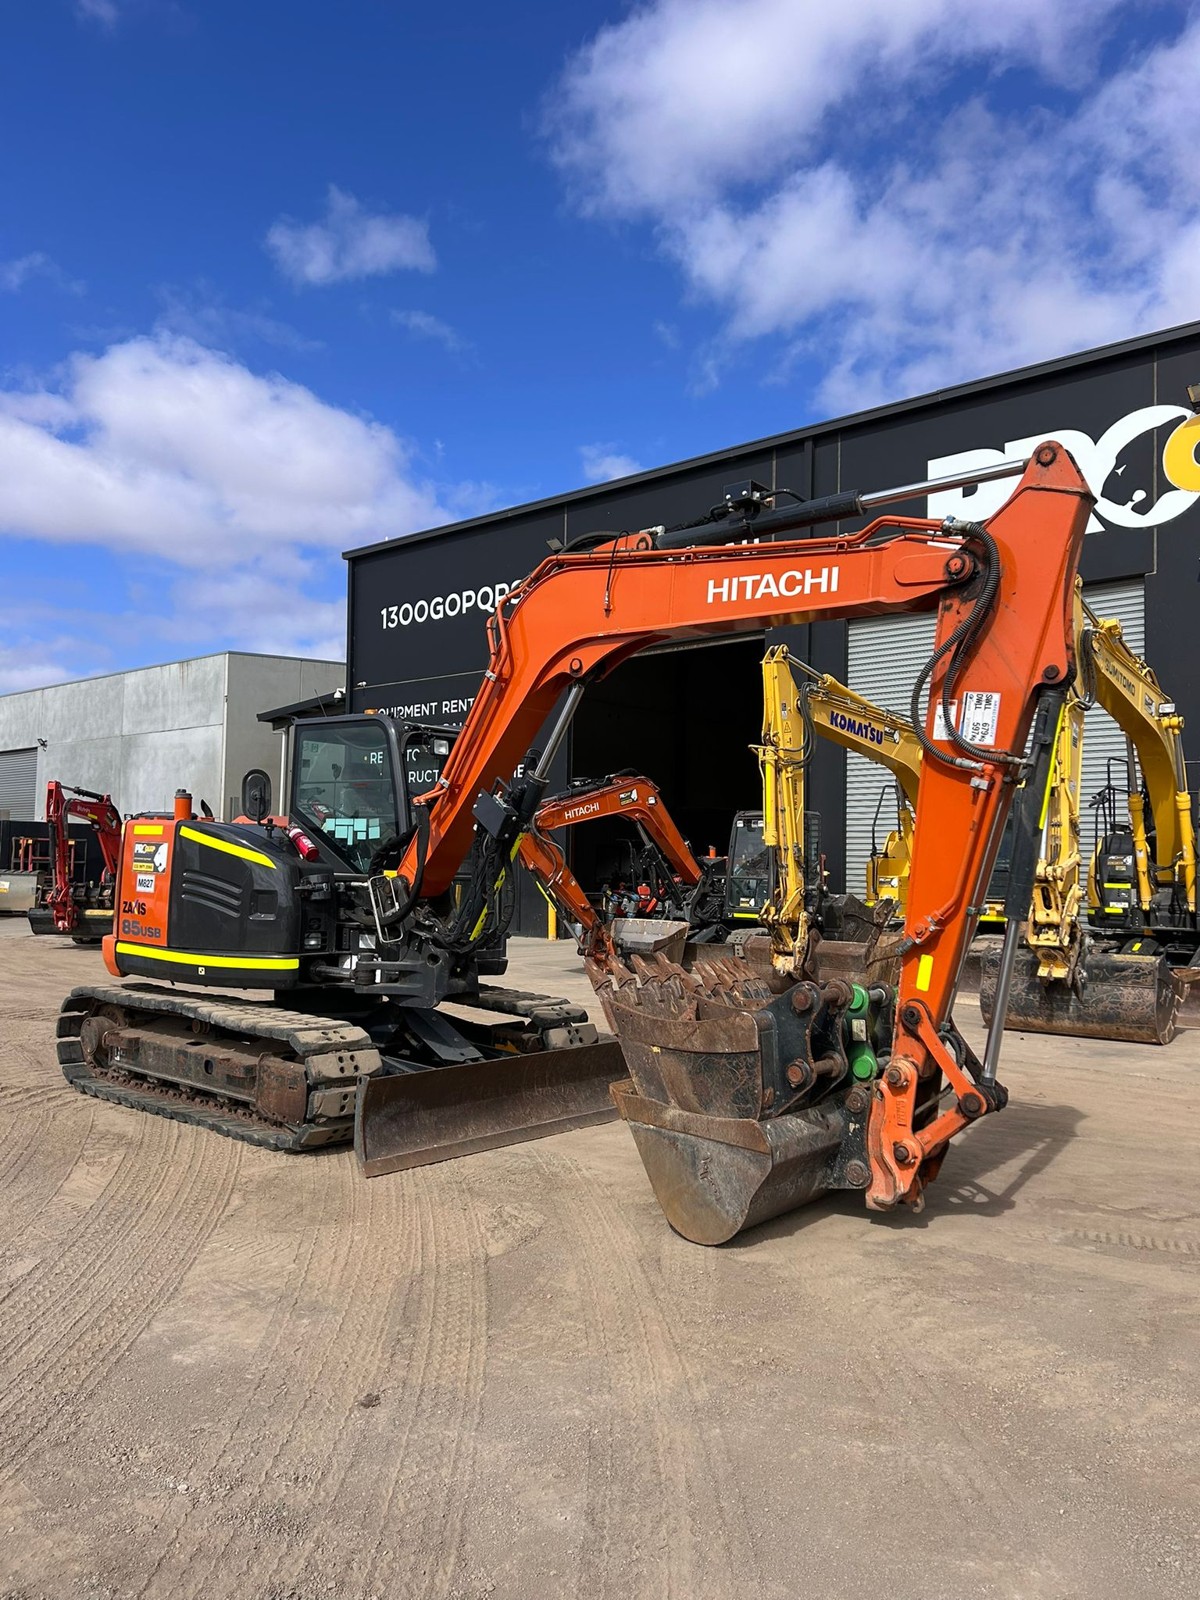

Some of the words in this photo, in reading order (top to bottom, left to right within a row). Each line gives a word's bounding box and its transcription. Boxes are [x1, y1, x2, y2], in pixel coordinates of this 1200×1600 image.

[706, 566, 840, 604] HITACHI
[442, 697, 475, 714] RENT
[829, 709, 884, 745] KOMATSU
[369, 752, 384, 764] RE
[408, 769, 439, 784] RUCT
[564, 802, 600, 820] HITACHI
[138, 878, 154, 889] M827
[122, 899, 147, 916] ZAXIS
